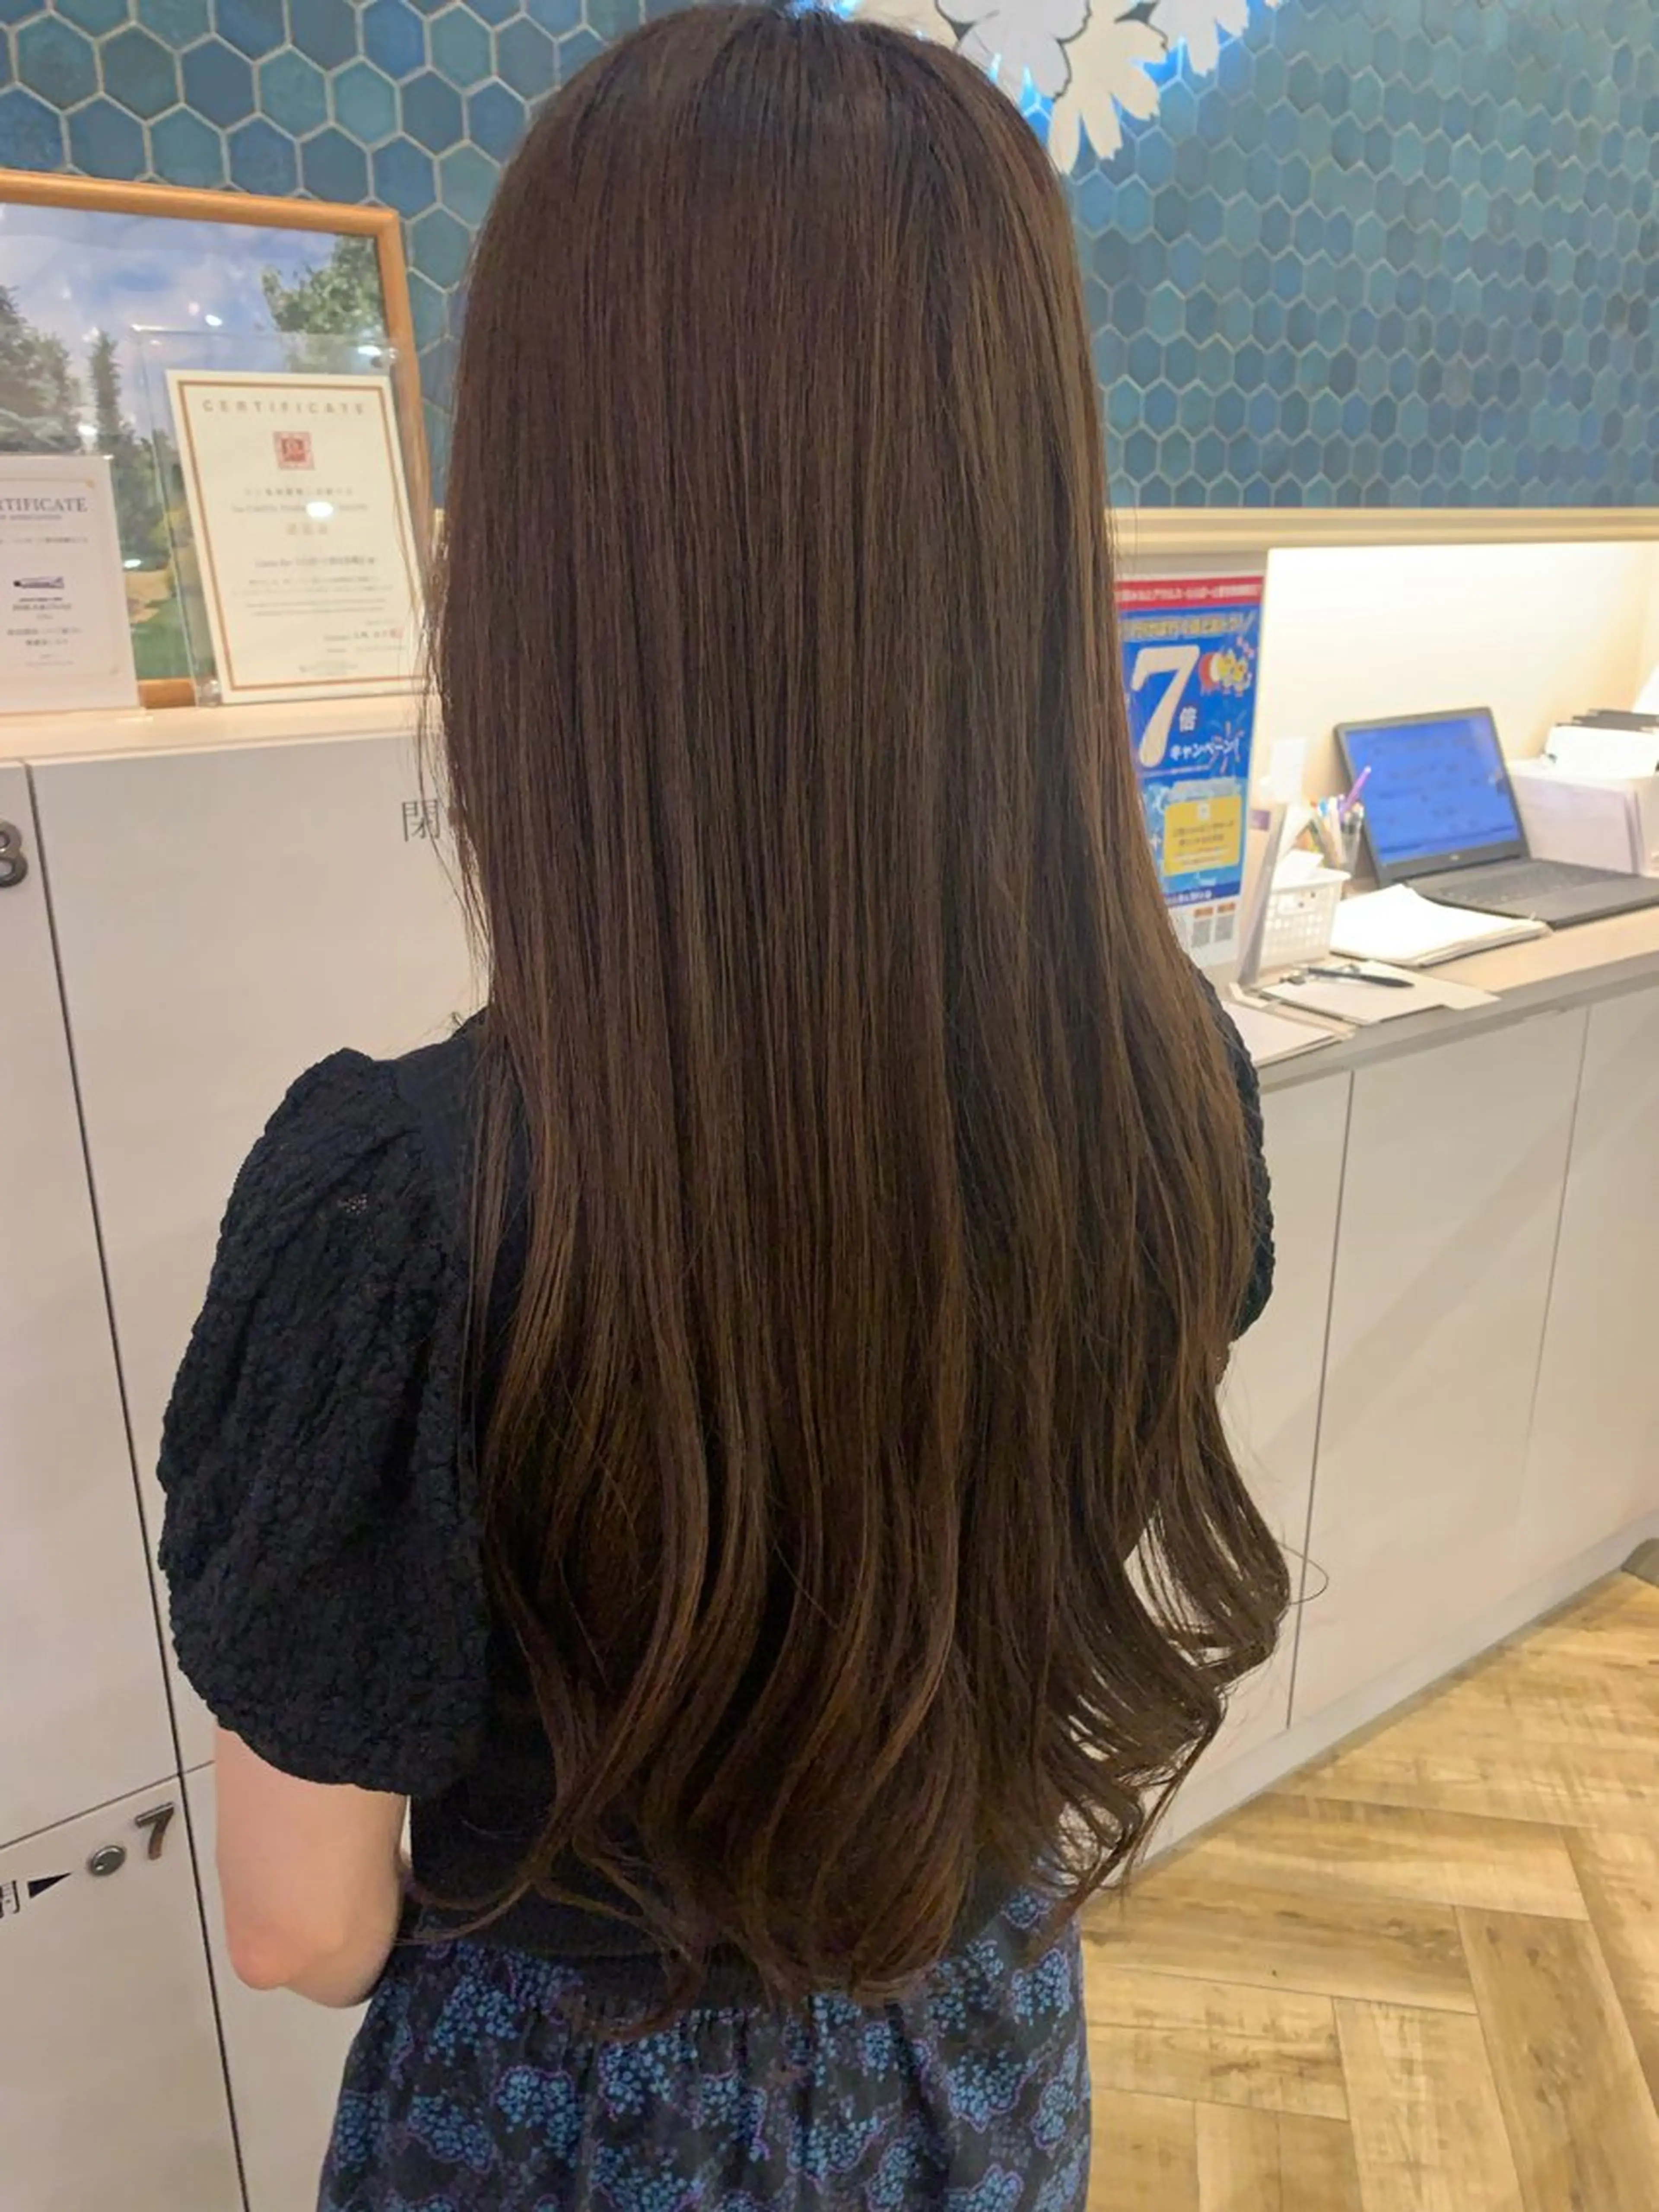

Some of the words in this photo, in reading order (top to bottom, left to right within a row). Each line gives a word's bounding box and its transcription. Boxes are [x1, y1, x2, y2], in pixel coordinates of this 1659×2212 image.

[202, 398, 365, 416] CERTIFICATE
[0, 498, 88, 512] TIFICATE
[1131, 644, 1200, 768] 7
[135, 1801, 175, 1861] 7
